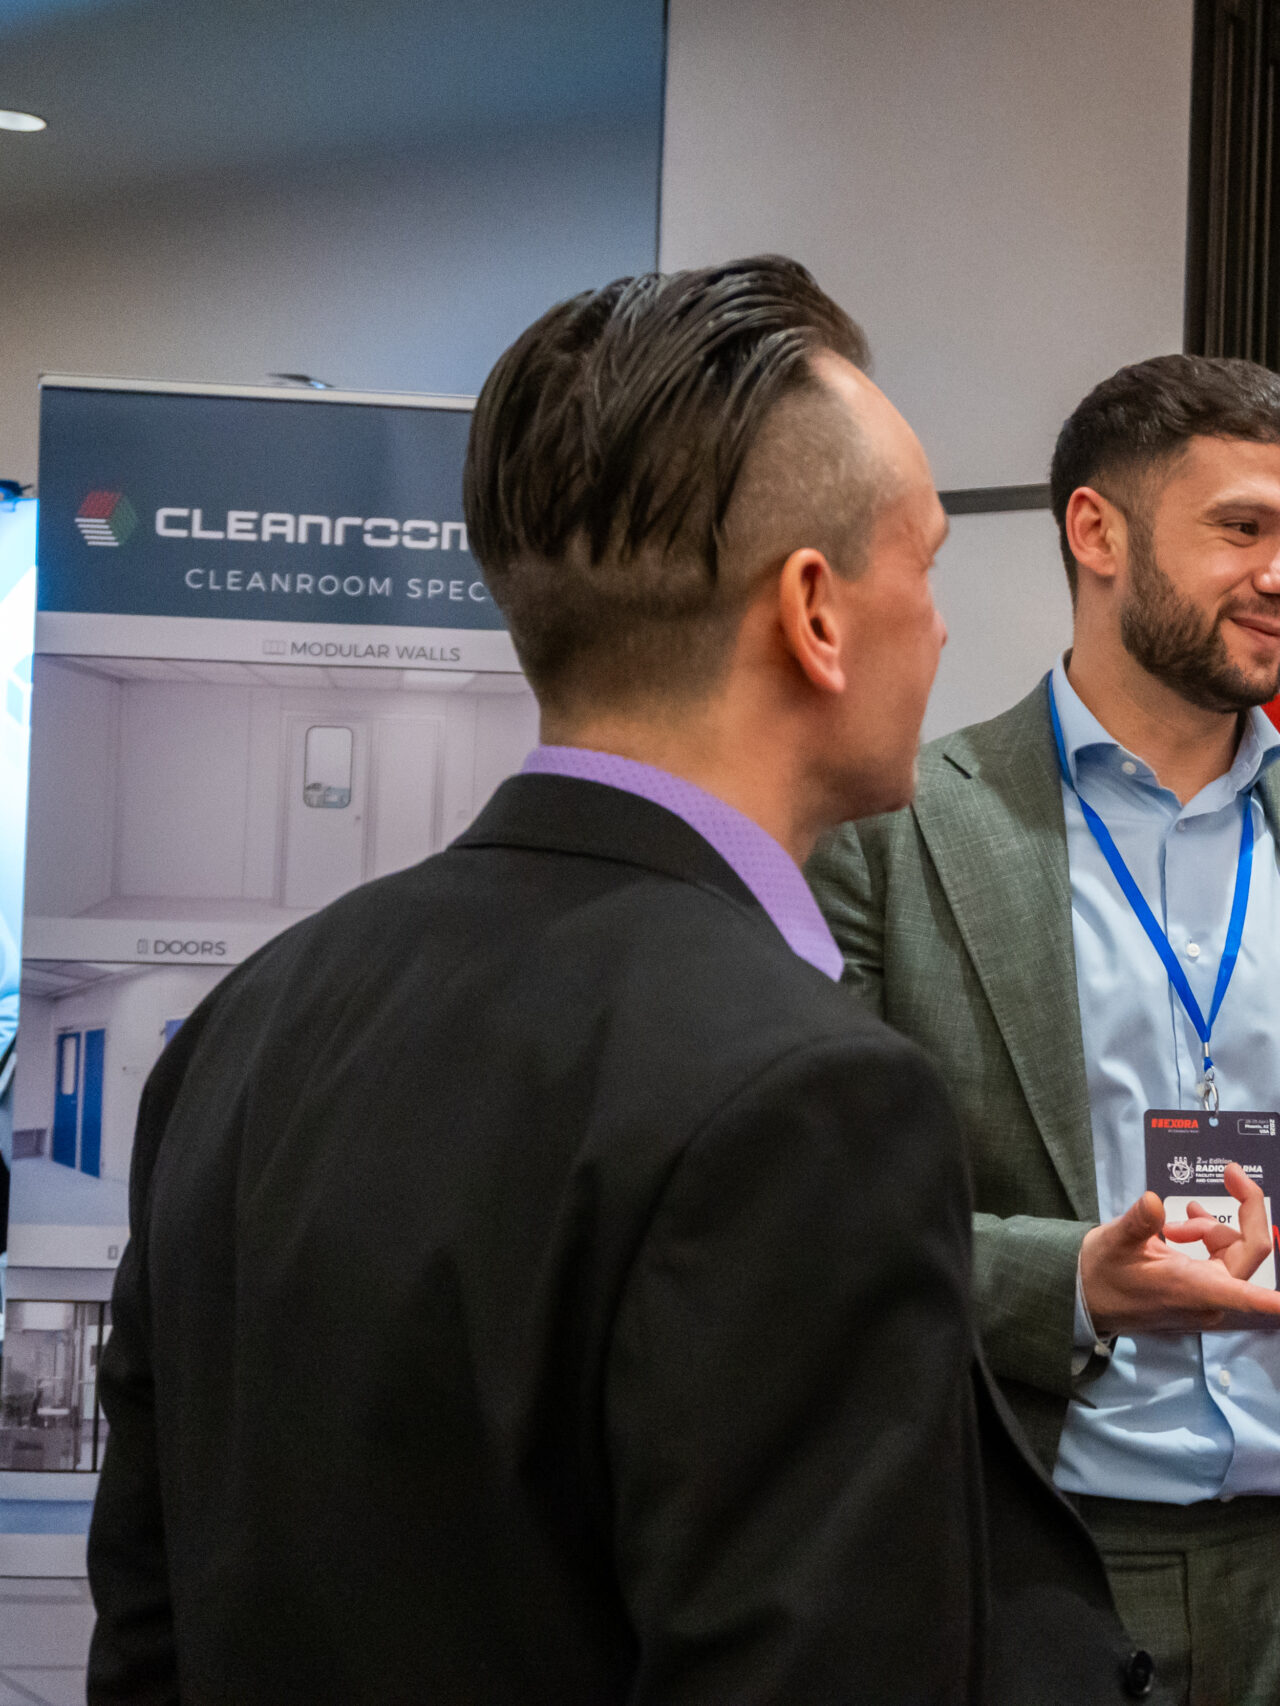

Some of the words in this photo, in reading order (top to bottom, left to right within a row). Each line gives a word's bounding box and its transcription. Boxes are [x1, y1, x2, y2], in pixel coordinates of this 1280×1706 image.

[185, 568, 391, 597] CLEANROOM
[290, 641, 390, 660] MODULAR
[395, 645, 461, 662] WALLS
[154, 940, 226, 956] DOORS
